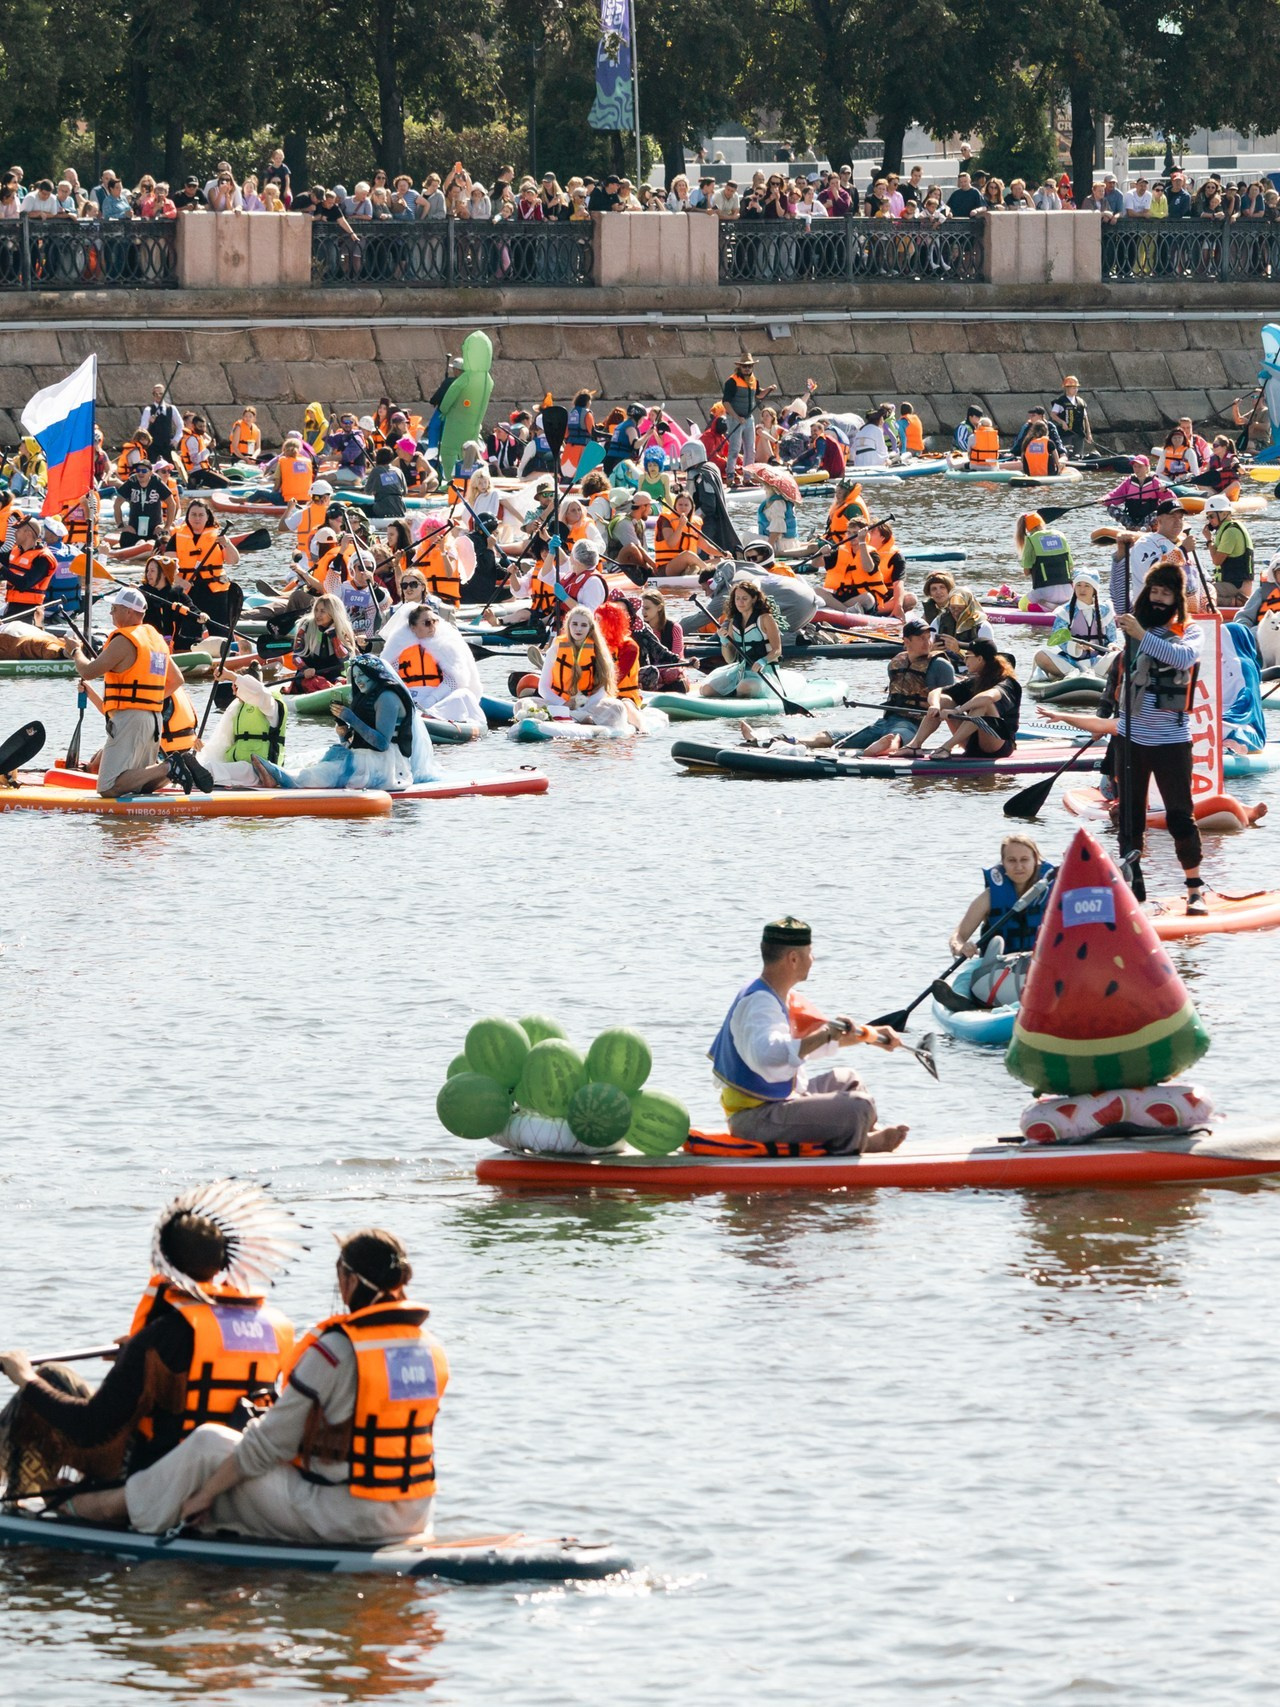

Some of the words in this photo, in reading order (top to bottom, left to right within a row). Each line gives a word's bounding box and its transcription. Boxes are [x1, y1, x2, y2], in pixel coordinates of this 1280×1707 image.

[127, 808, 156, 816] TURBO
[157, 808, 171, 816] 366
[1074, 899, 1103, 914] 0067
